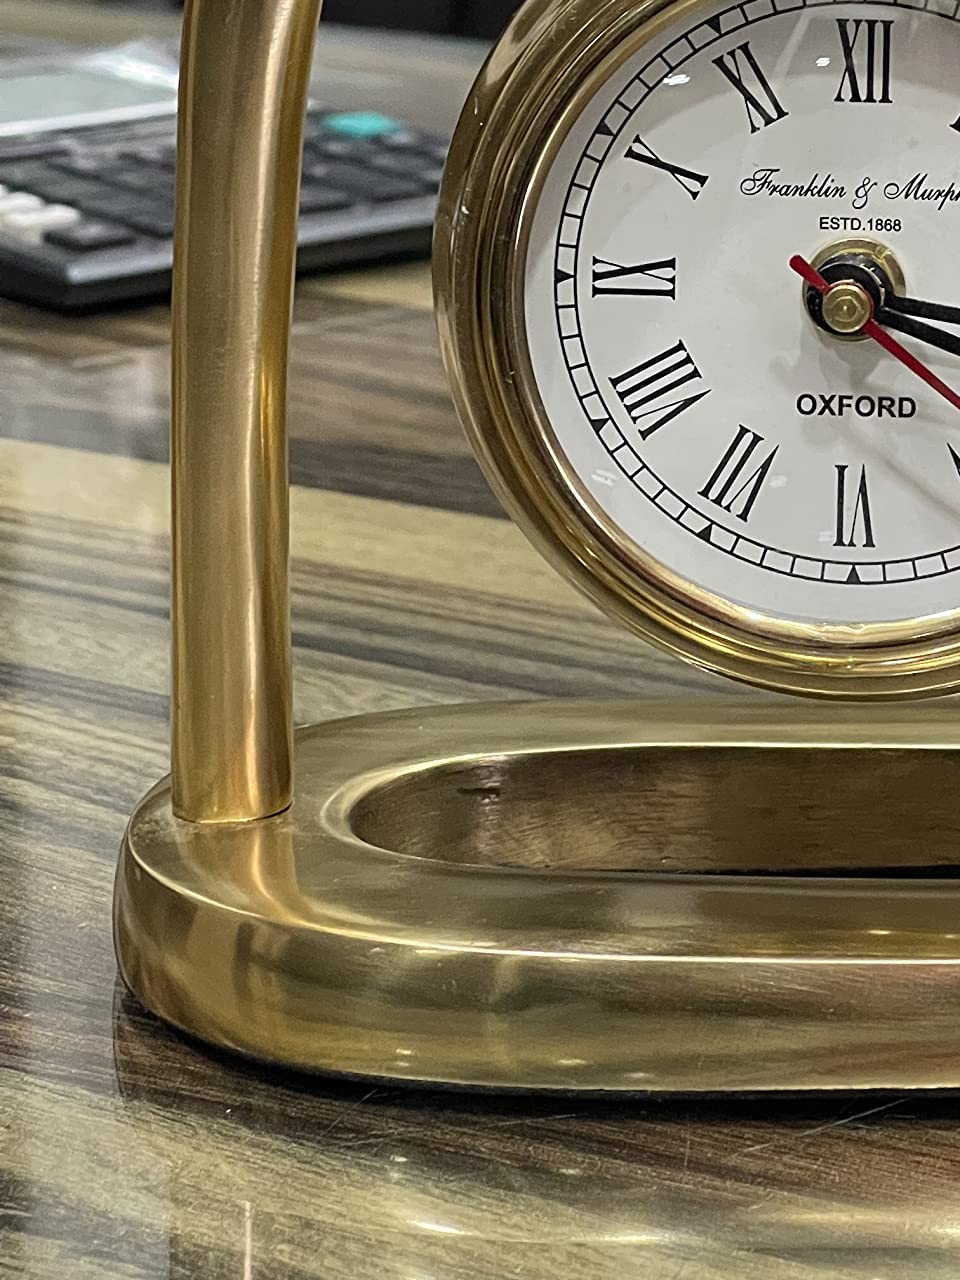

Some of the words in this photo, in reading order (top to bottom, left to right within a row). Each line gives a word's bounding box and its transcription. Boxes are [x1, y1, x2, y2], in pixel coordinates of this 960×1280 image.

[712, 41, 788, 133] XI
[834, 19, 895, 103] XII
[624, 134, 708, 200] X
[740, 169, 847, 197] Franklin
[852, 177, 878, 210] &
[819, 217, 901, 231] ESTD.1868
[592, 256, 676, 300] IX
[608, 340, 711, 440] VIII
[797, 394, 917, 417] OXFORD
[698, 425, 779, 522] VII
[833, 464, 875, 547] VI
